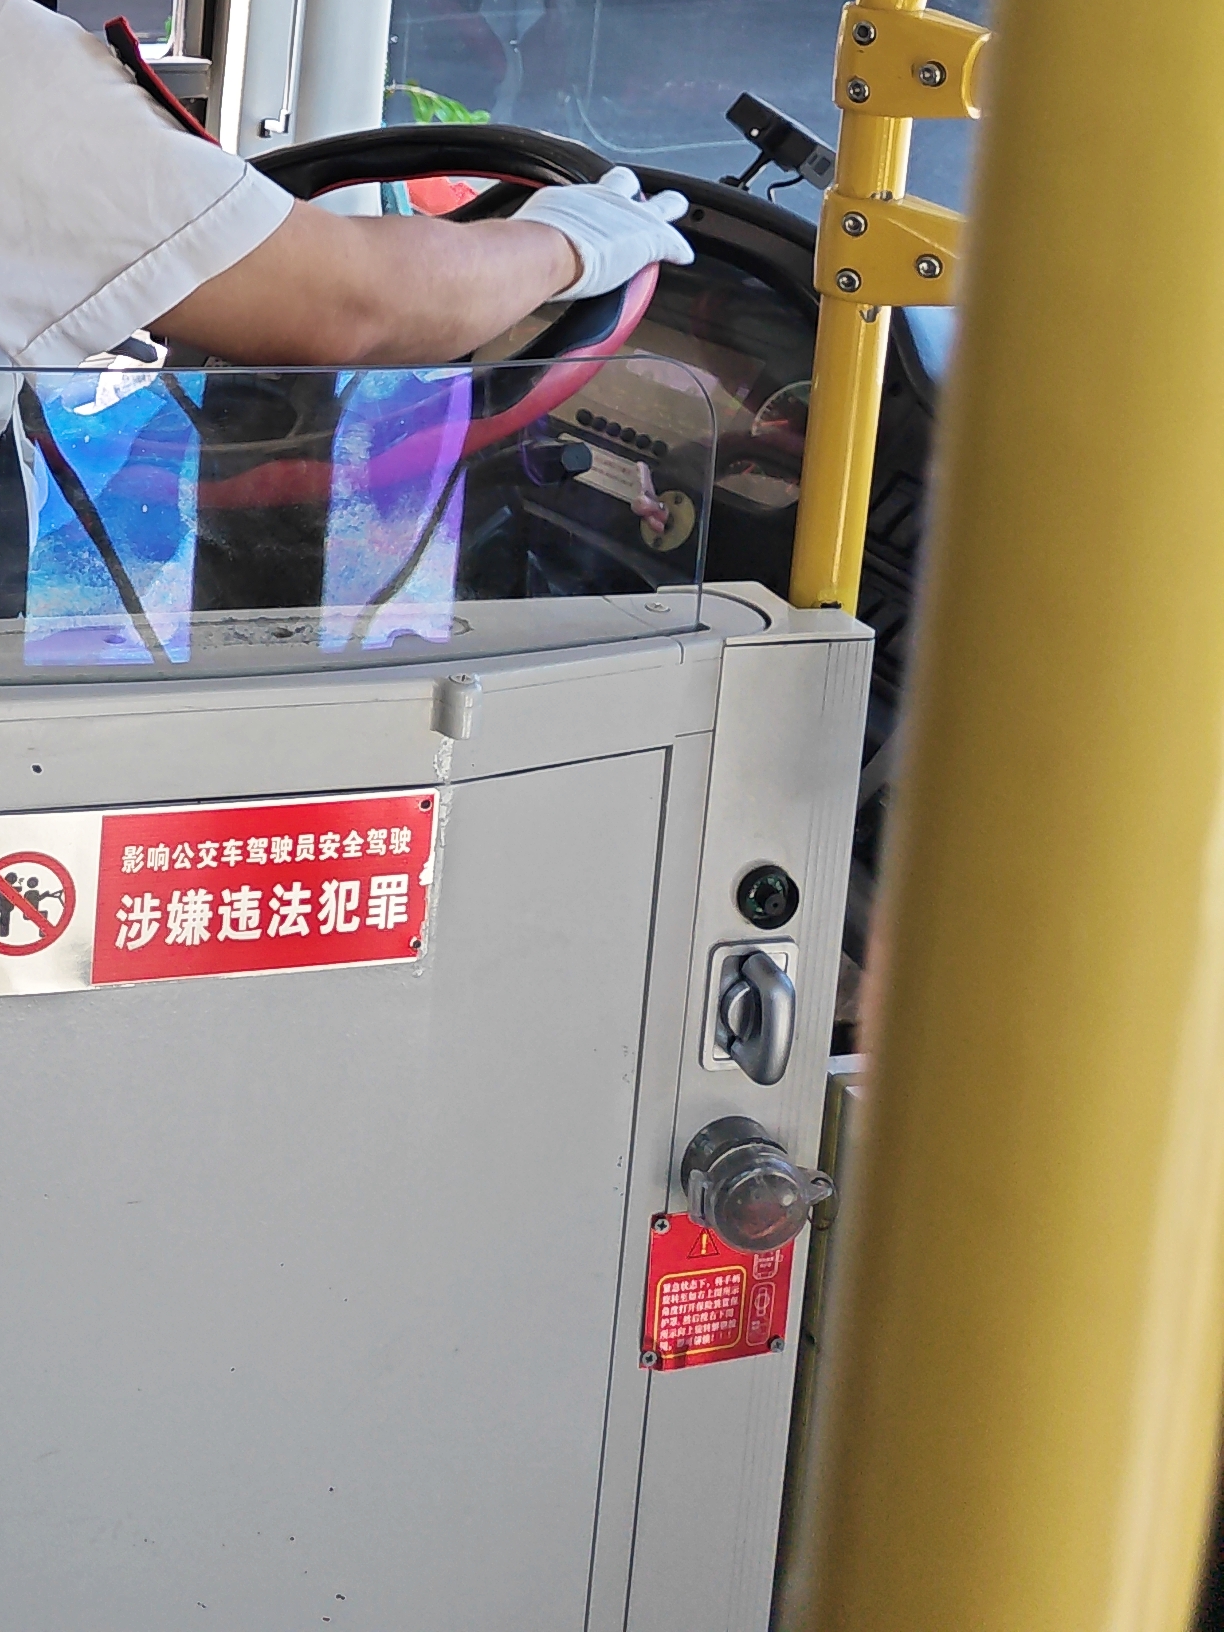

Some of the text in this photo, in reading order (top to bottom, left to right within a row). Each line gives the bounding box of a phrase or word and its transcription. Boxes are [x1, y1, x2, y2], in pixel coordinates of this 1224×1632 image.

[122, 825, 413, 874] 影响公交车驾驶员安全驾驶
[114, 873, 410, 951] 涉嫌违法犯罪
